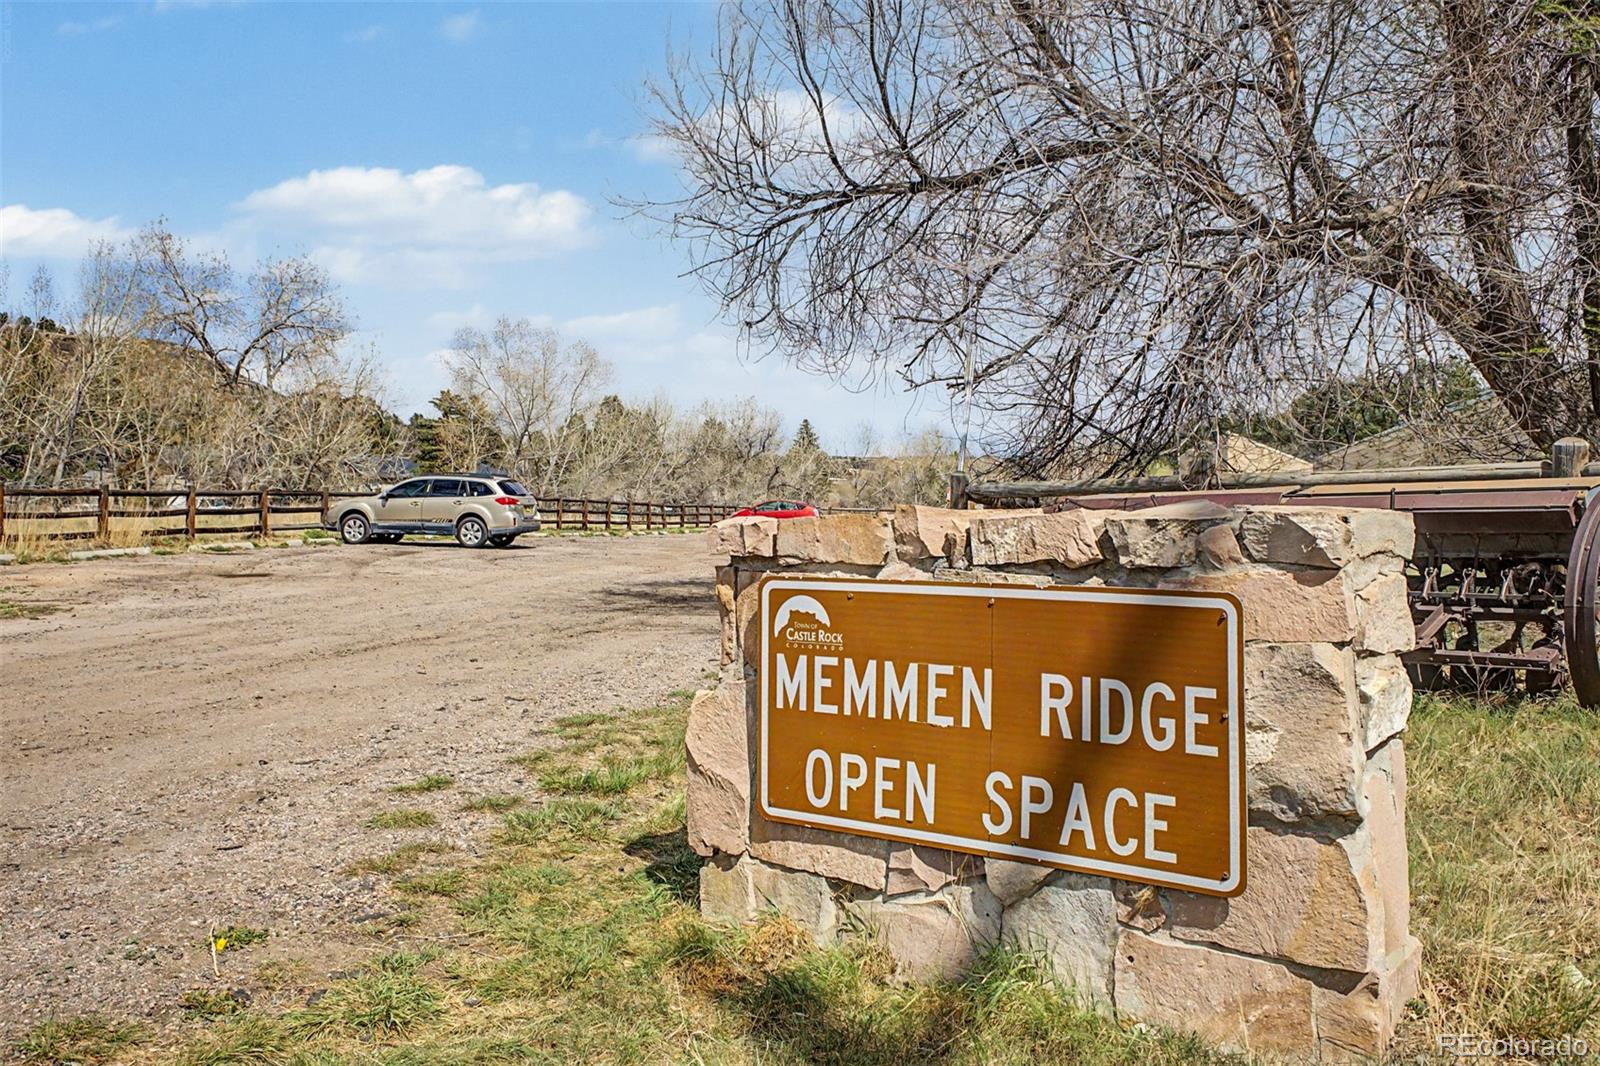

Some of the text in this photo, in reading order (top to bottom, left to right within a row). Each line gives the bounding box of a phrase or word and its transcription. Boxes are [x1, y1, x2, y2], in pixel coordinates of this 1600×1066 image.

[786, 627, 843, 643] CASTLE ROCK
[786, 642, 844, 651] COLORADO
[775, 653, 1219, 758] MEMMEN RIDGE
[805, 748, 1178, 865] OPEN SPACE
